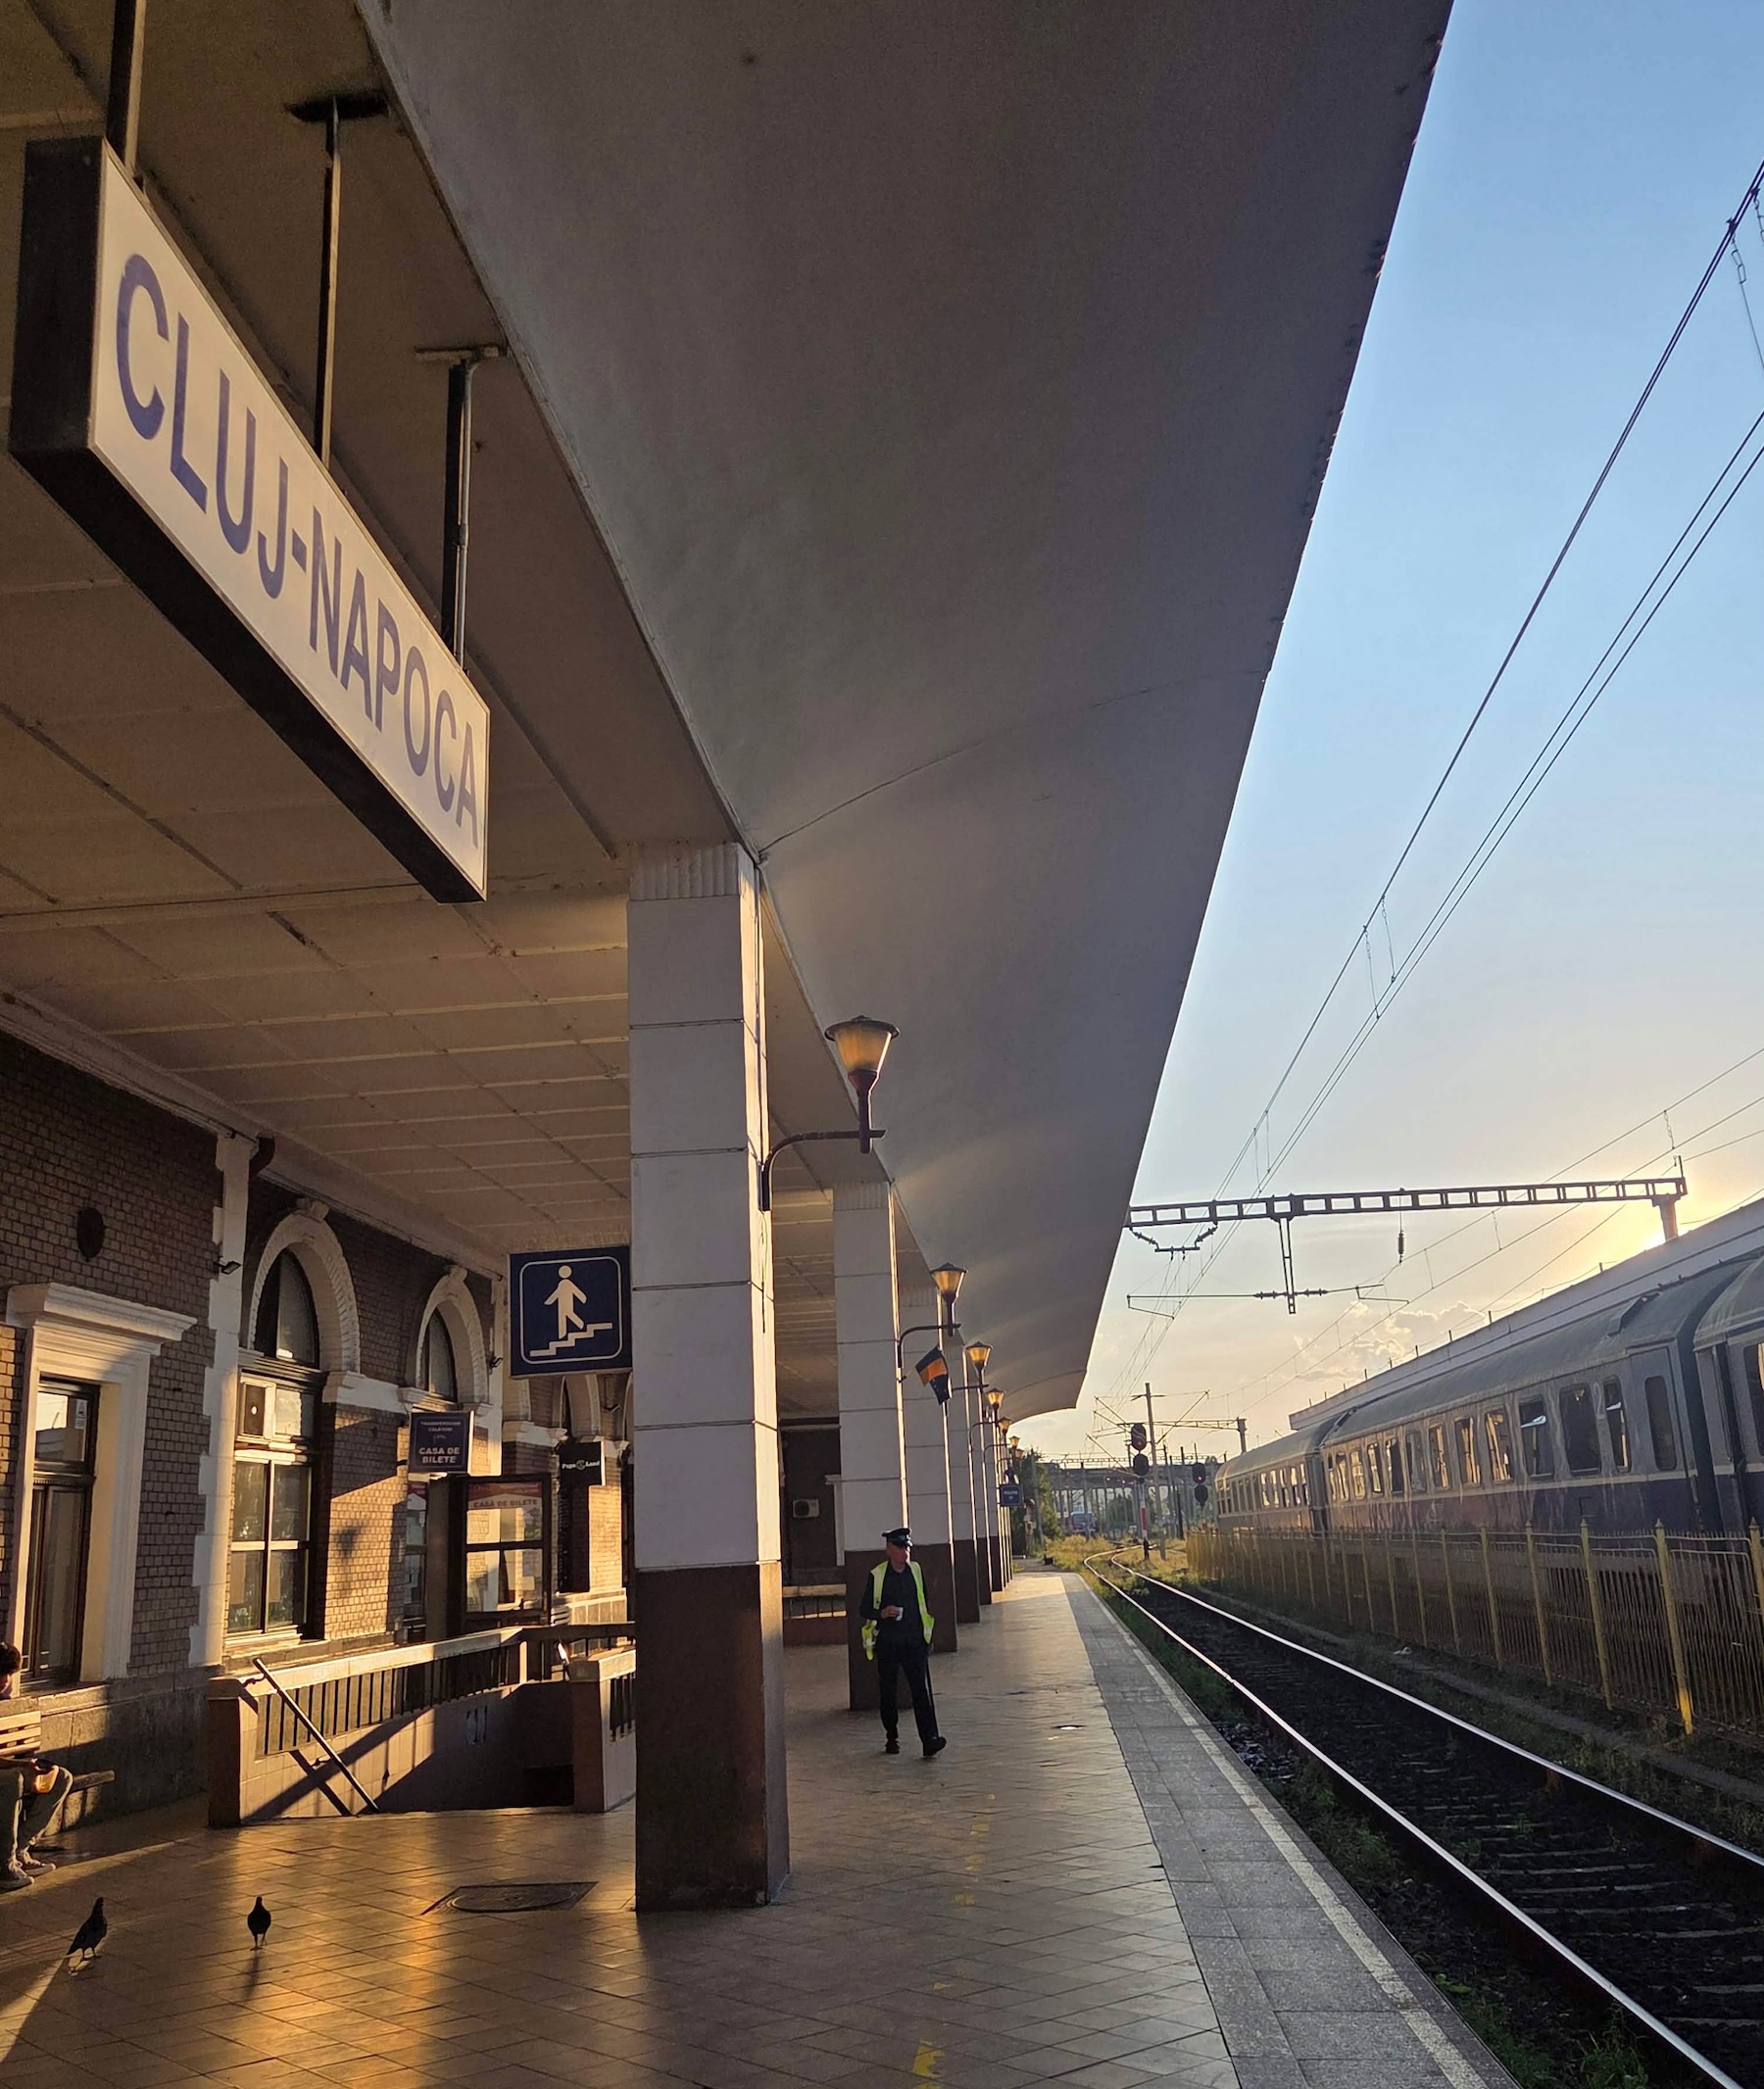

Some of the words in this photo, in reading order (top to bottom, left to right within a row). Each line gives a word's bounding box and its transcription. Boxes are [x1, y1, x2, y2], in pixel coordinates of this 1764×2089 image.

[116, 252, 480, 850] CLUJ-NAPOCA
[1592, 1382, 1606, 1420] 2
[418, 1446, 446, 1455] CASA
[447, 1446, 461, 1455] DE
[421, 1455, 457, 1464] BILETE
